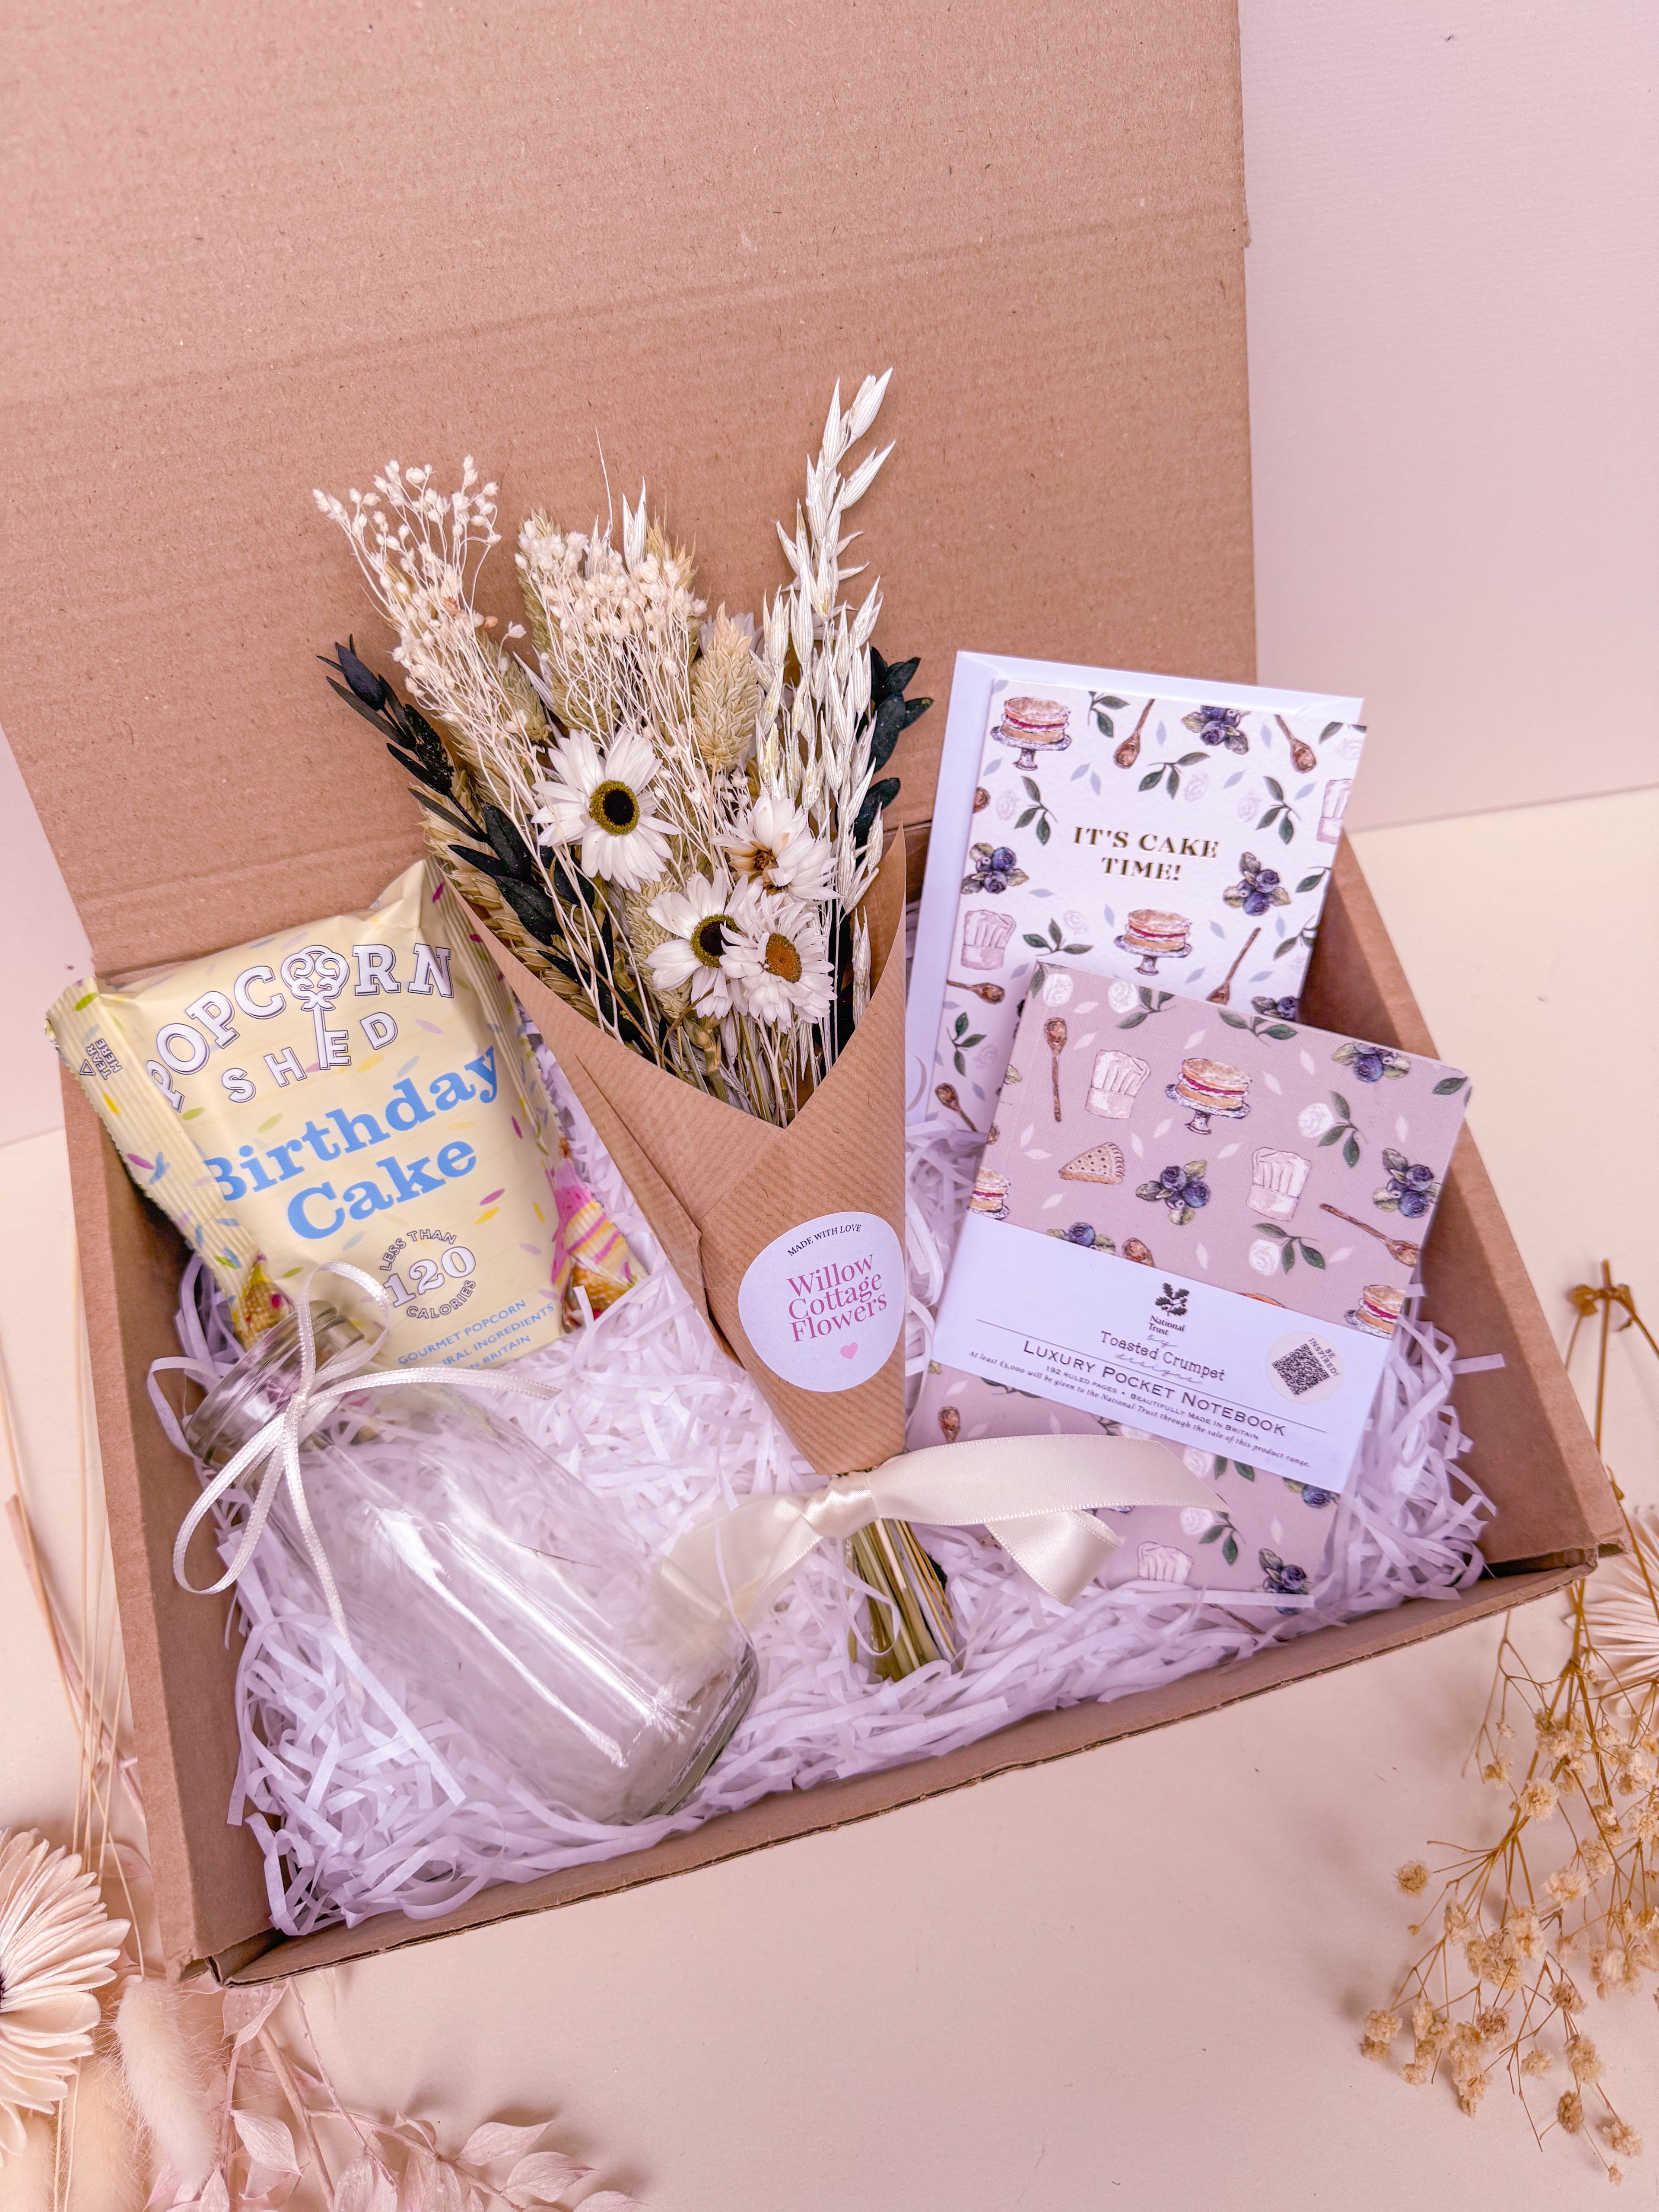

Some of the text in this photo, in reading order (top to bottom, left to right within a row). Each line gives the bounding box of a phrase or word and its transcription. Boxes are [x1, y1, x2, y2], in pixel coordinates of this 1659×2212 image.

[1073, 827, 1220, 859] IT'S CAKE
[1102, 857, 1182, 883] TIME!
[147, 944, 454, 1112] POPCORN
[86, 1043, 111, 1080] TEAR
[95, 1038, 123, 1073] HERE
[222, 1012, 398, 1103] SHED
[204, 1045, 497, 1201] Birthday
[287, 1141, 476, 1239] Cake
[380, 1229, 457, 1271] LESS THAN
[788, 1224, 861, 1256] MADE WITH LOVE
[383, 1246, 476, 1308] 120
[787, 1254, 873, 1297] Willow
[407, 1280, 476, 1319] CALORIES
[788, 1274, 882, 1319] Cottage
[398, 1299, 526, 1365] GOURMET POPCORN
[474, 1303, 554, 1350] INGREDIENTS
[790, 1294, 887, 1342] Flowers
[1148, 1322, 1168, 1335] Trust
[1150, 1315, 1185, 1332] National
[483, 1335, 531, 1363] BRITAIN
[1101, 1330, 1225, 1381] Toasted Crumpet
[1115, 1354, 1202, 1383] designs
[1308, 1338, 1339, 1376] INSPIRED!
[1325, 1348, 1335, 1358] BE
[1046, 1366, 1061, 1374] 192
[1063, 1372, 1090, 1384] RULED
[1092, 1382, 1117, 1393] PAGES
[980, 1354, 997, 1364] least
[999, 1360, 1025, 1373] £5,000
[1054, 1380, 1075, 1389] given
[1101, 1394, 1135, 1409] National
[1137, 1405, 1158, 1417] Trust
[1160, 1414, 1190, 1428] through
[1207, 1430, 1223, 1438] sale
[1235, 1439, 1251, 1448] this
[1252, 1444, 1284, 1459] product
[1286, 1455, 1310, 1467] range.
